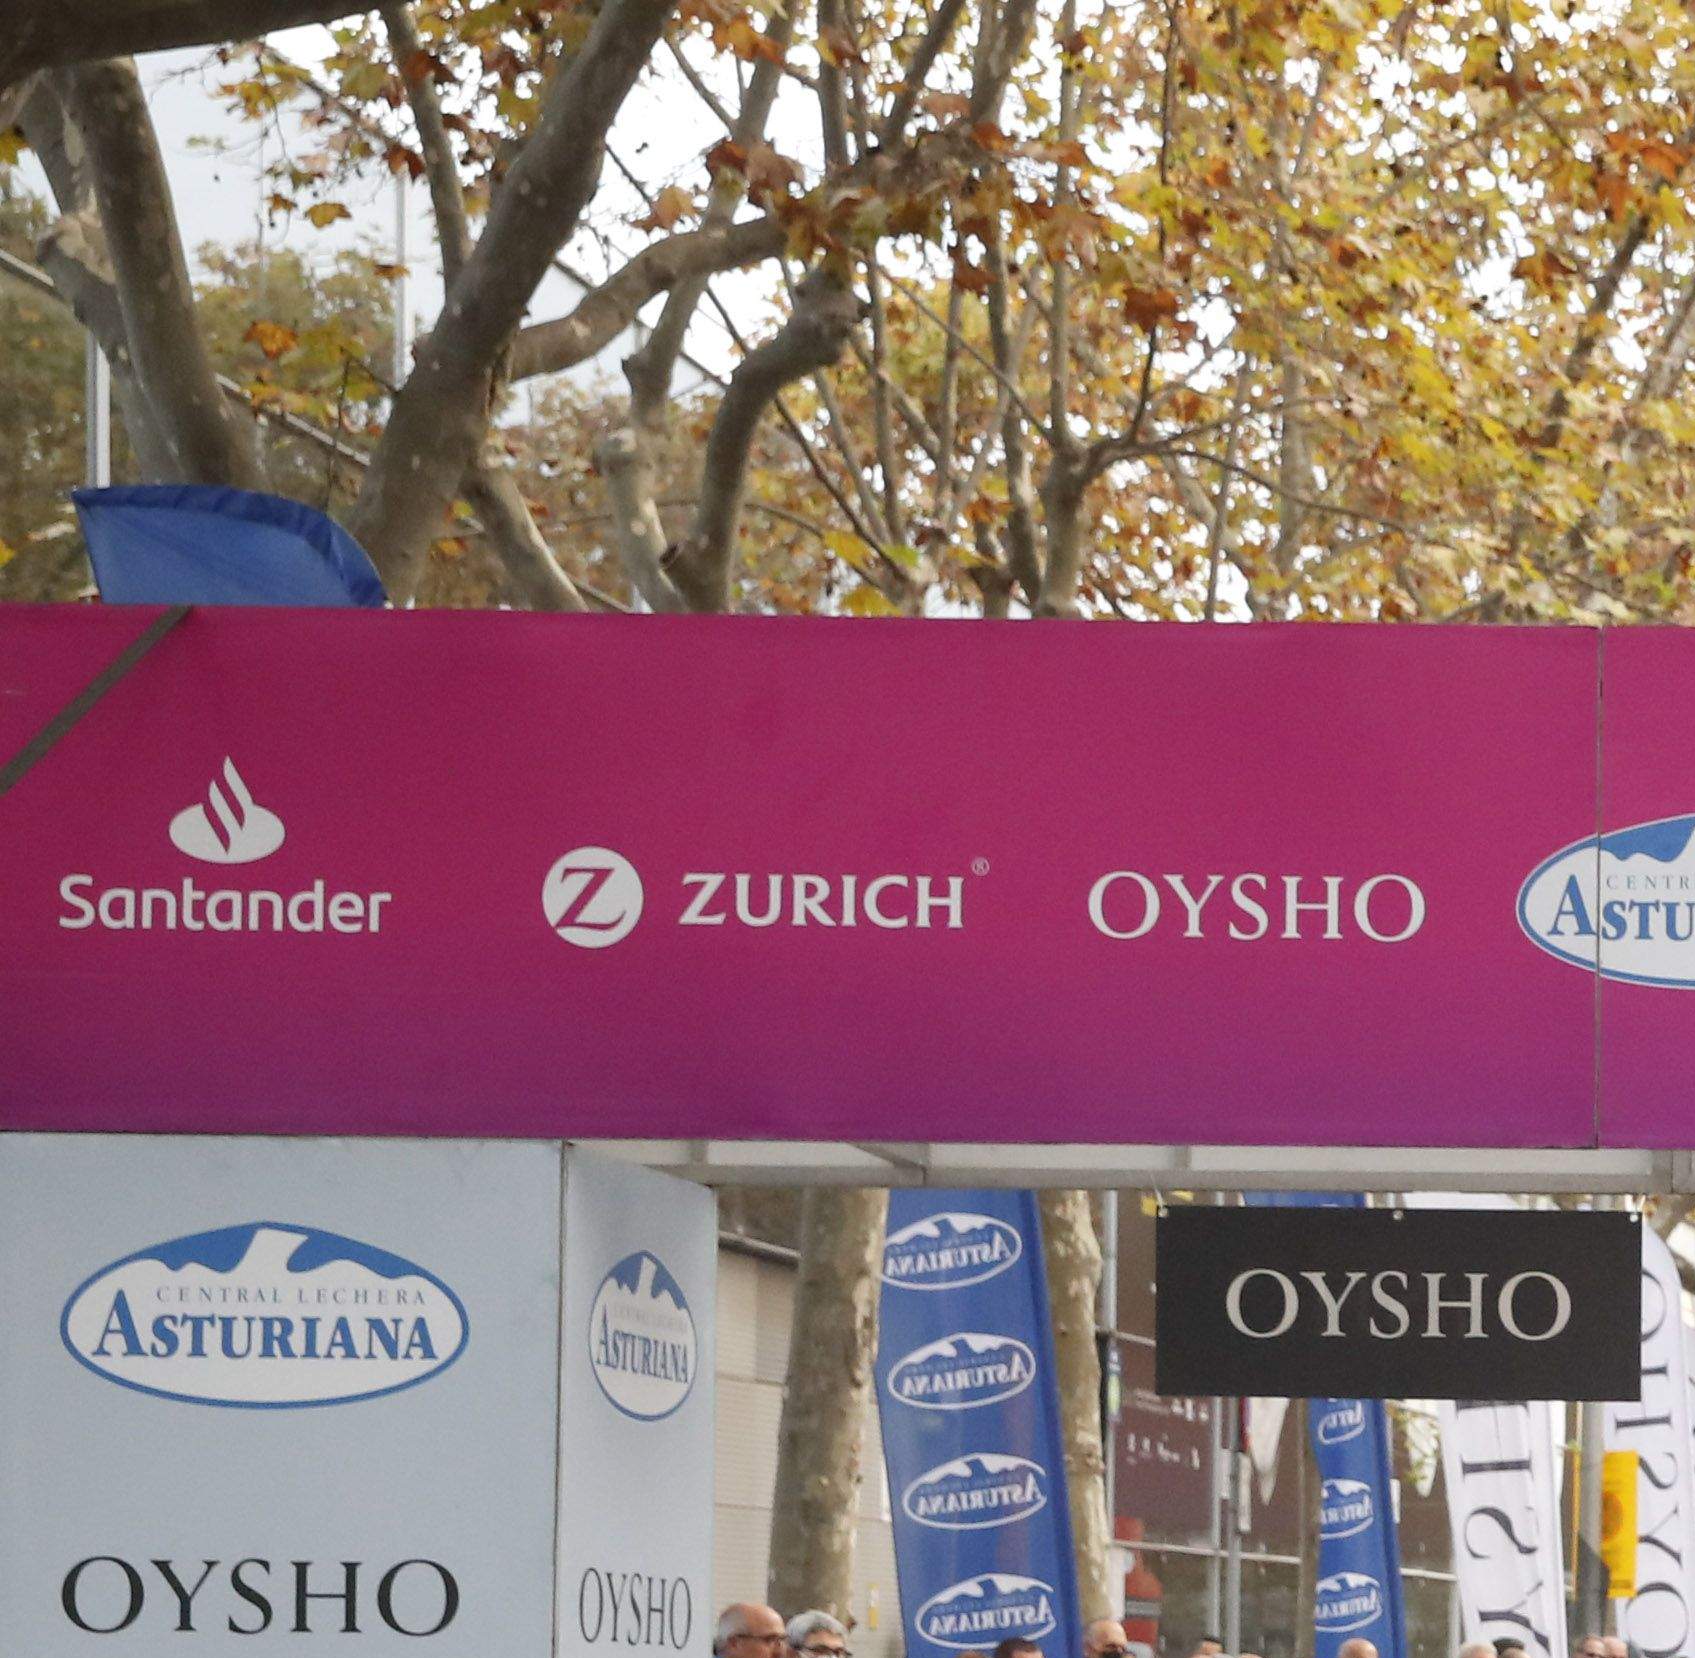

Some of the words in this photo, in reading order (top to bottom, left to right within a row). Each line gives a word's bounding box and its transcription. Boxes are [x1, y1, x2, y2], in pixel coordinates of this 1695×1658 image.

[58, 873, 392, 934] Santander
[678, 871, 964, 929] ZURICH
[1086, 869, 1428, 943] OYSHO
[90, 1288, 439, 1361] ASTURIANA
[156, 1285, 283, 1305] CENTRAL
[298, 1286, 427, 1306] LECHERA
[1225, 1267, 1572, 1341] OYSHO
[596, 1318, 690, 1386] ASTURIANA
[60, 1555, 460, 1637] OYSHO
[578, 1565, 692, 1651] OYSHO
